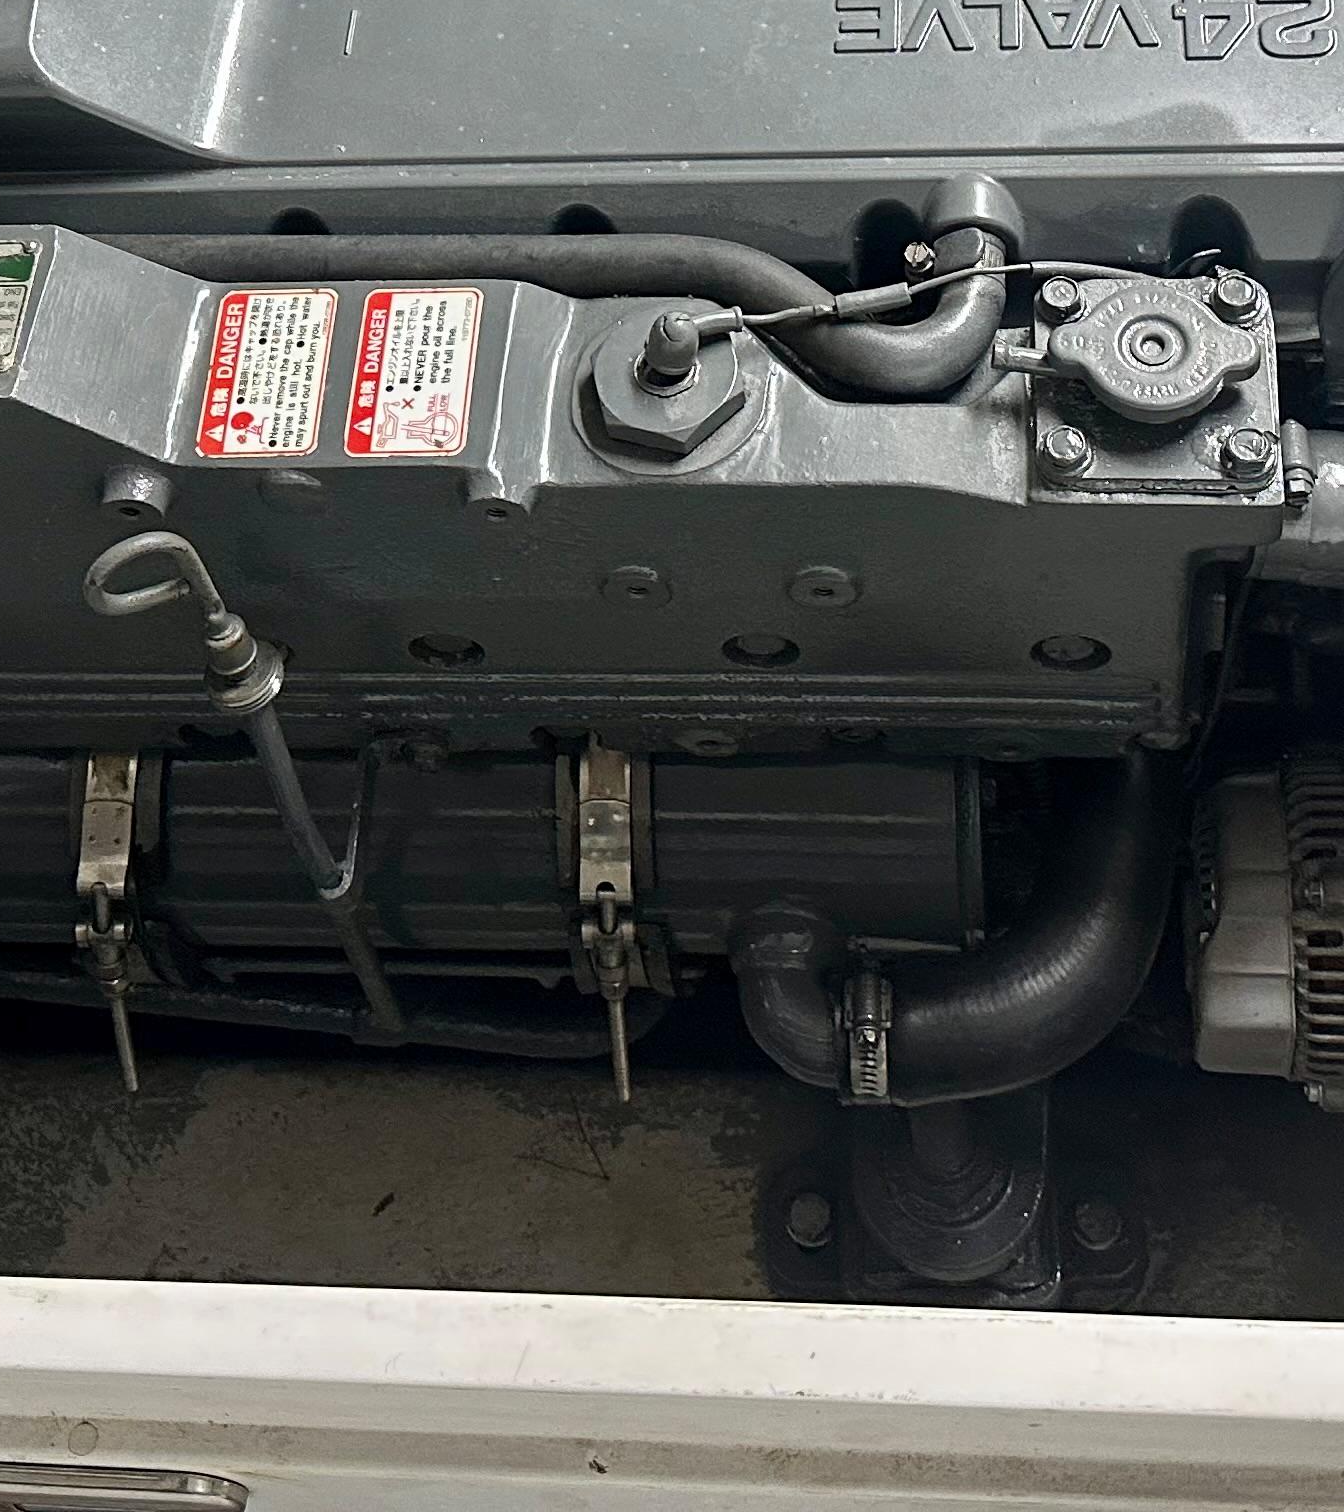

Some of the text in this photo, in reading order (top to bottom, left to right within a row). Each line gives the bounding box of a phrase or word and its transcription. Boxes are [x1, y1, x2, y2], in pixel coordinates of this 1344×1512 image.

[301, 296, 312, 320] water
[216, 303, 244, 378] DANGER
[296, 325, 307, 340] Hot
[364, 309, 387, 373] DANGER
[415, 306, 433, 383] NEVER pour the
[430, 300, 447, 383] engine oil across
[306, 342, 318, 362] burn
[441, 326, 457, 383] the full line.
[270, 297, 299, 439] Never remove the cap while the
[304, 365, 314, 381] and
[288, 381, 298, 397] still
[301, 384, 311, 399] out
[358, 380, 376, 408] 危険
[210, 387, 230, 417] 危険
[285, 403, 295, 411] is
[297, 401, 310, 425] spurt
[427, 395, 435, 412] FULL
[439, 395, 447, 412] LOW
[282, 416, 294, 448] engine
[295, 428, 306, 447] may
